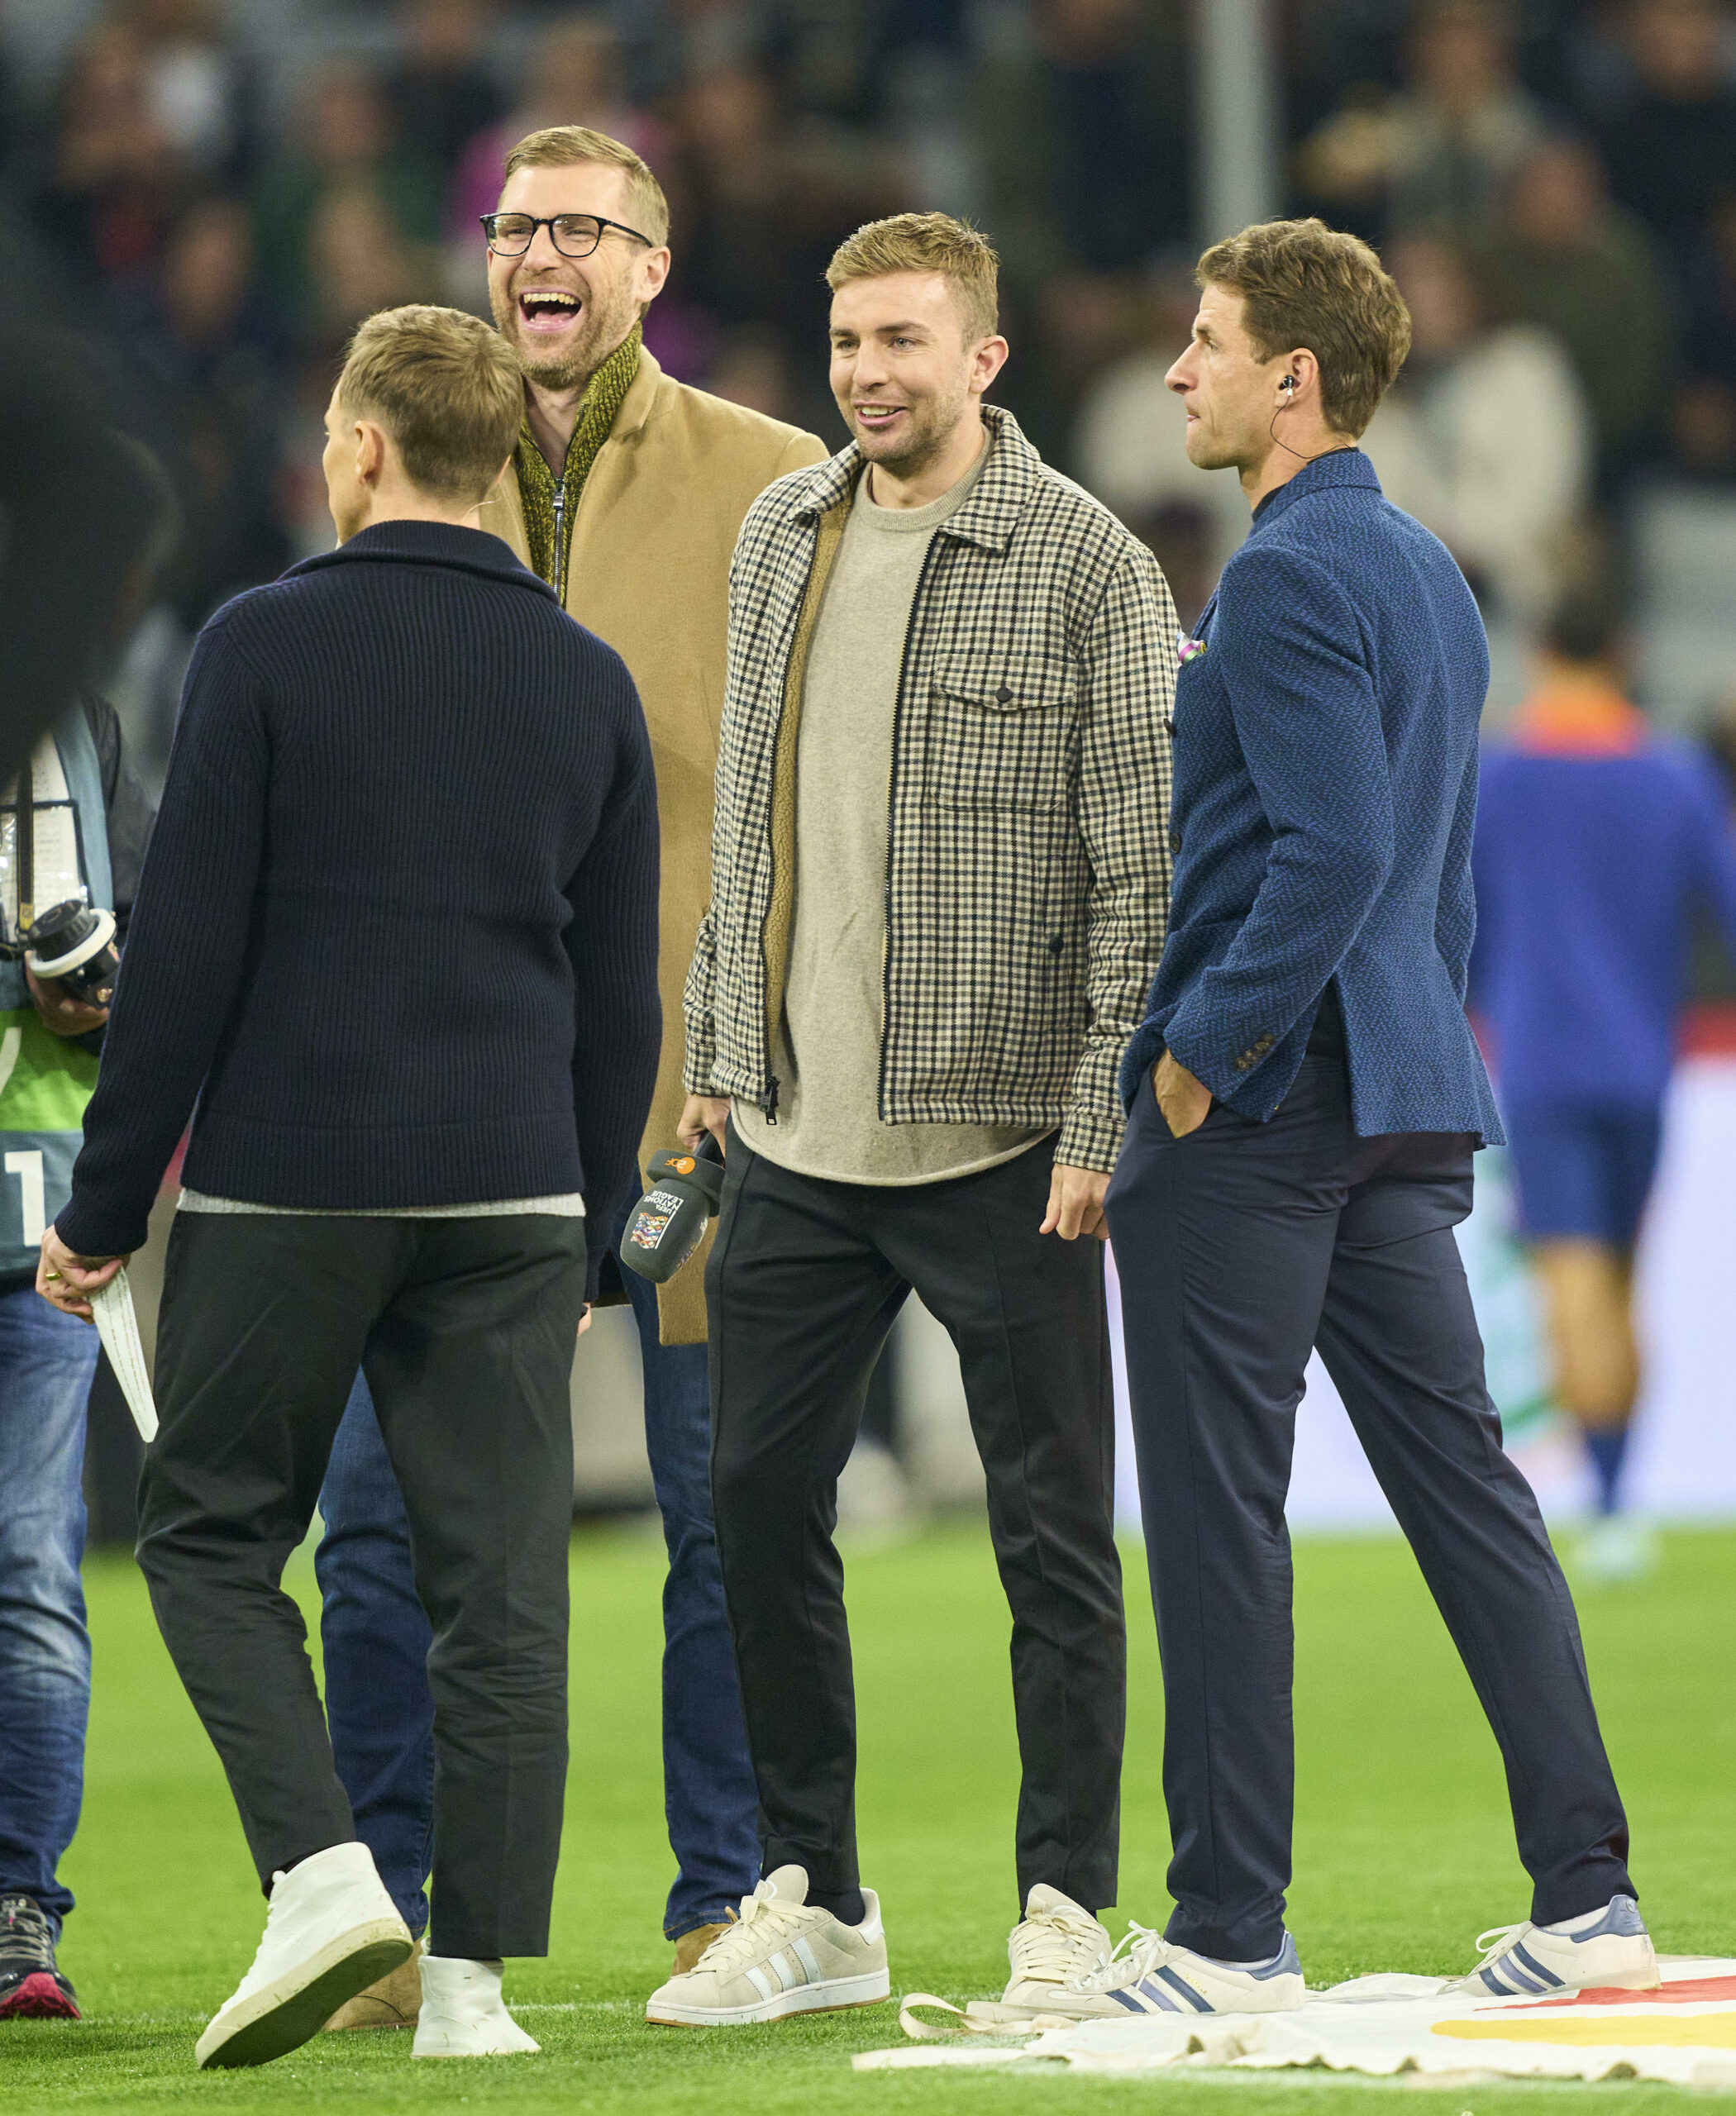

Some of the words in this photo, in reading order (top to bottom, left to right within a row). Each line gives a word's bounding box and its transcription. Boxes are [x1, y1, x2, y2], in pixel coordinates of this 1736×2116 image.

[643, 1195, 680, 1211] NATIONS
[651, 1190, 684, 1205] LEAGUE
[656, 1204, 673, 1215] UEFA
